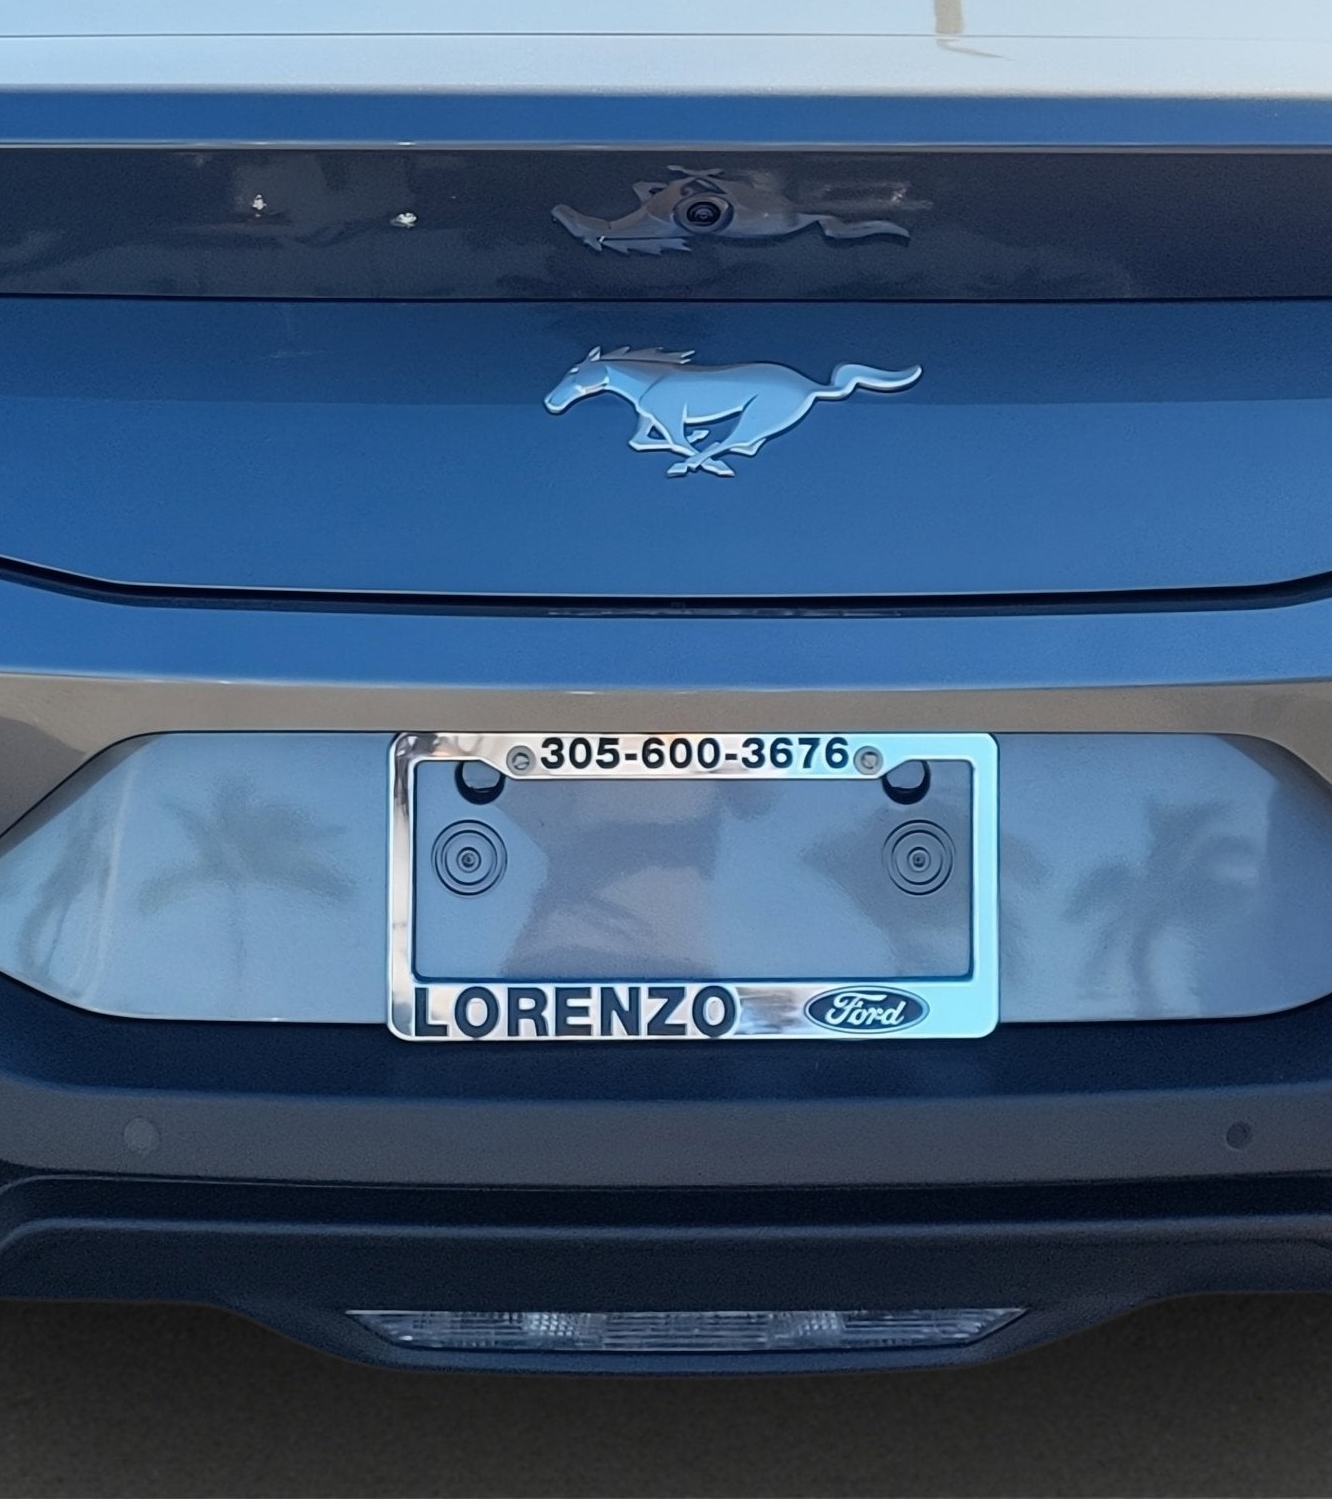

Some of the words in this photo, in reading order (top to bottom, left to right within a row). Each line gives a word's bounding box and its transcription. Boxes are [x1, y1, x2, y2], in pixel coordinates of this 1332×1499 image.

[540, 737, 850, 769] 305-600-3676
[414, 985, 737, 1038] LORENZO
[824, 992, 907, 1026] Ford
